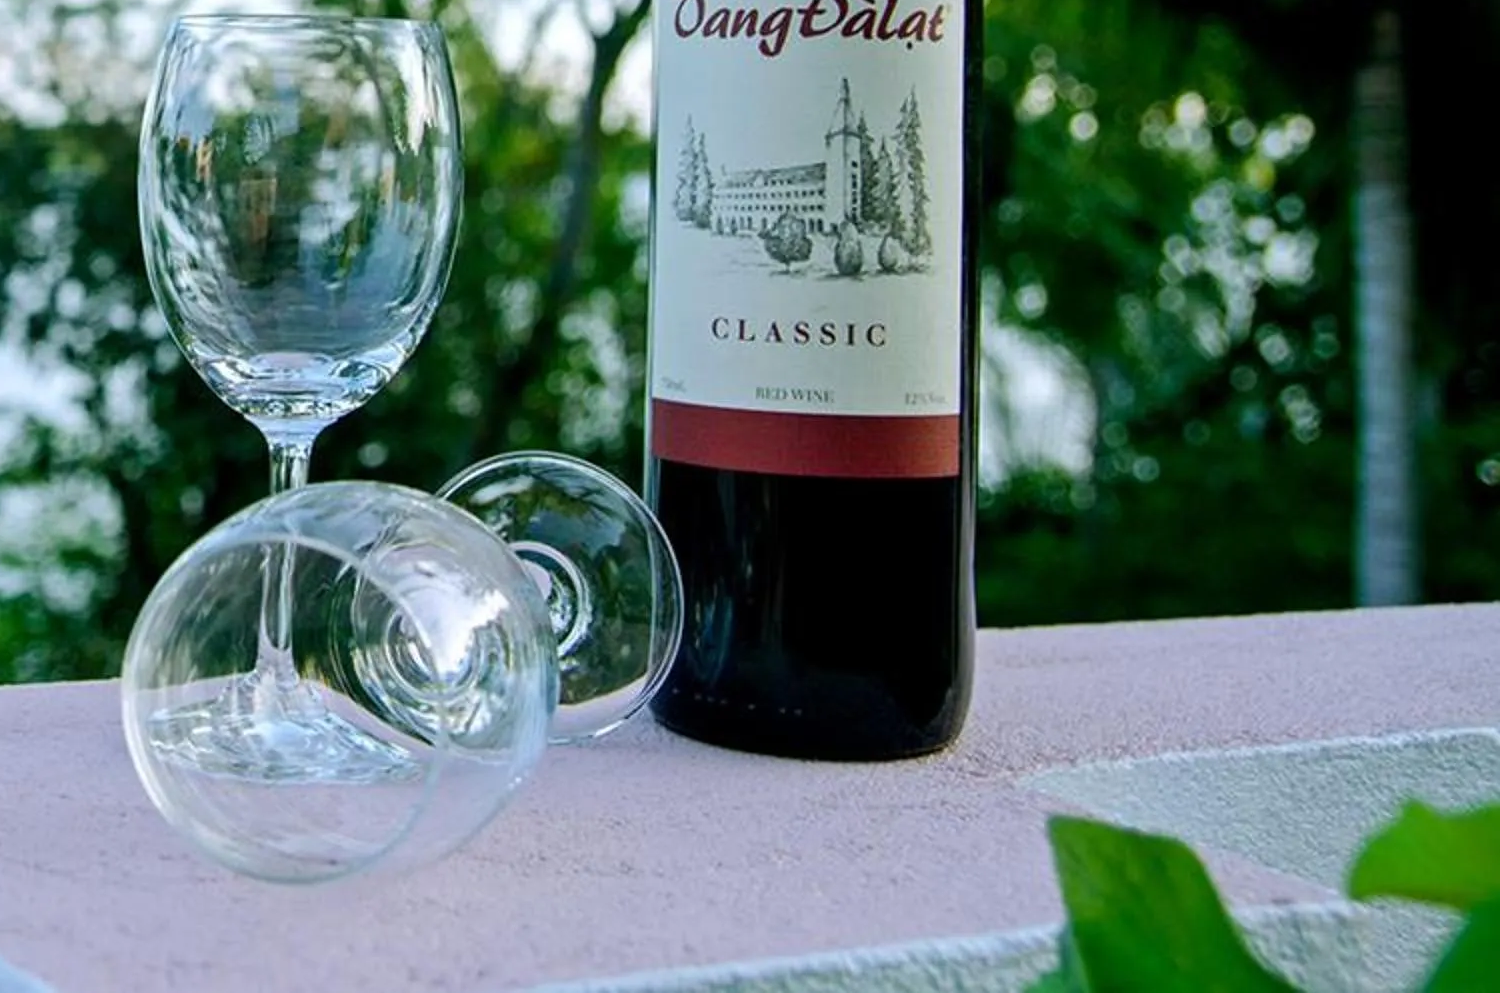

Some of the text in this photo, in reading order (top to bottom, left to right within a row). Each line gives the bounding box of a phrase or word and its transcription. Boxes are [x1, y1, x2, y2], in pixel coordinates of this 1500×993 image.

[711, 317, 887, 347] CLASSIC
[755, 387, 835, 404] RED WINE
